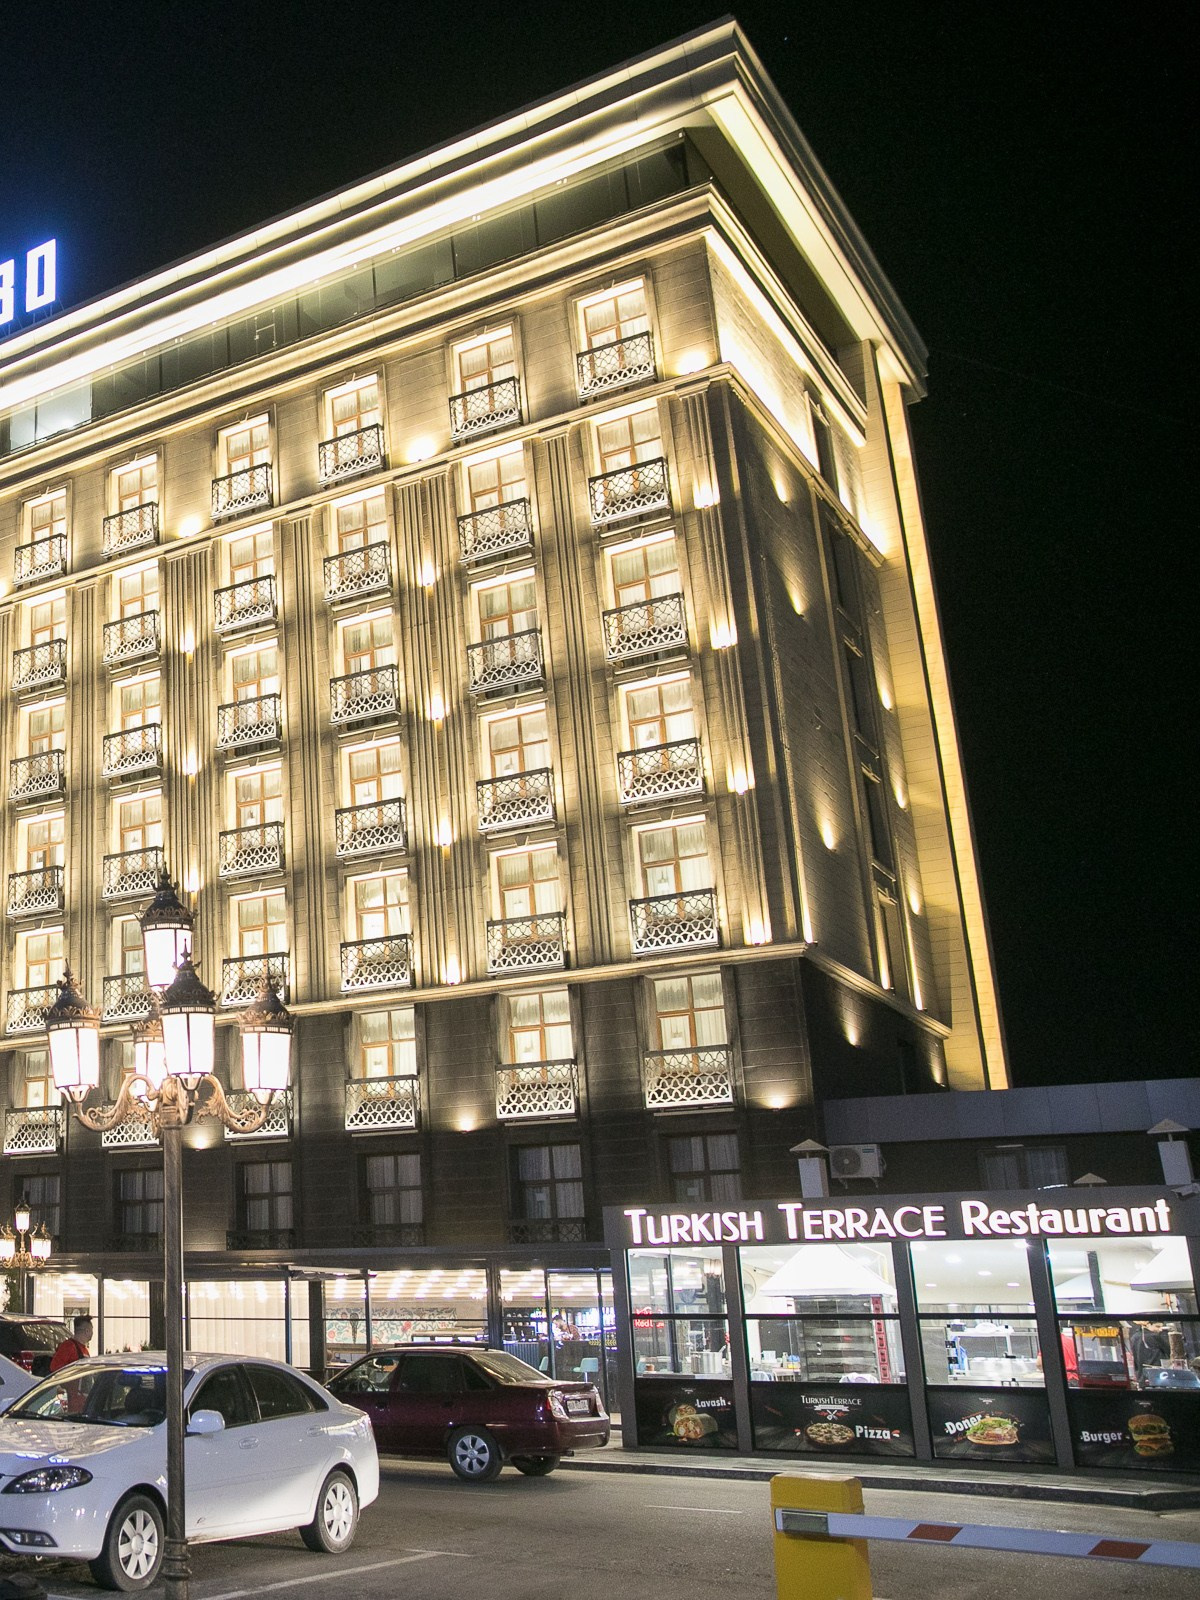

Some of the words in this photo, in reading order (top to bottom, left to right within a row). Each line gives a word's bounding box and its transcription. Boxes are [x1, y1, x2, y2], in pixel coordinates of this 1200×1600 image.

[623, 1208, 765, 1245] TURKISH
[777, 1203, 947, 1240] TERRACE
[960, 1198, 1171, 1236] Restaurant
[695, 1396, 726, 1408] Lavash
[944, 1414, 982, 1435] Doner
[855, 1425, 890, 1439] Pizza
[1081, 1430, 1122, 1443] Burger
